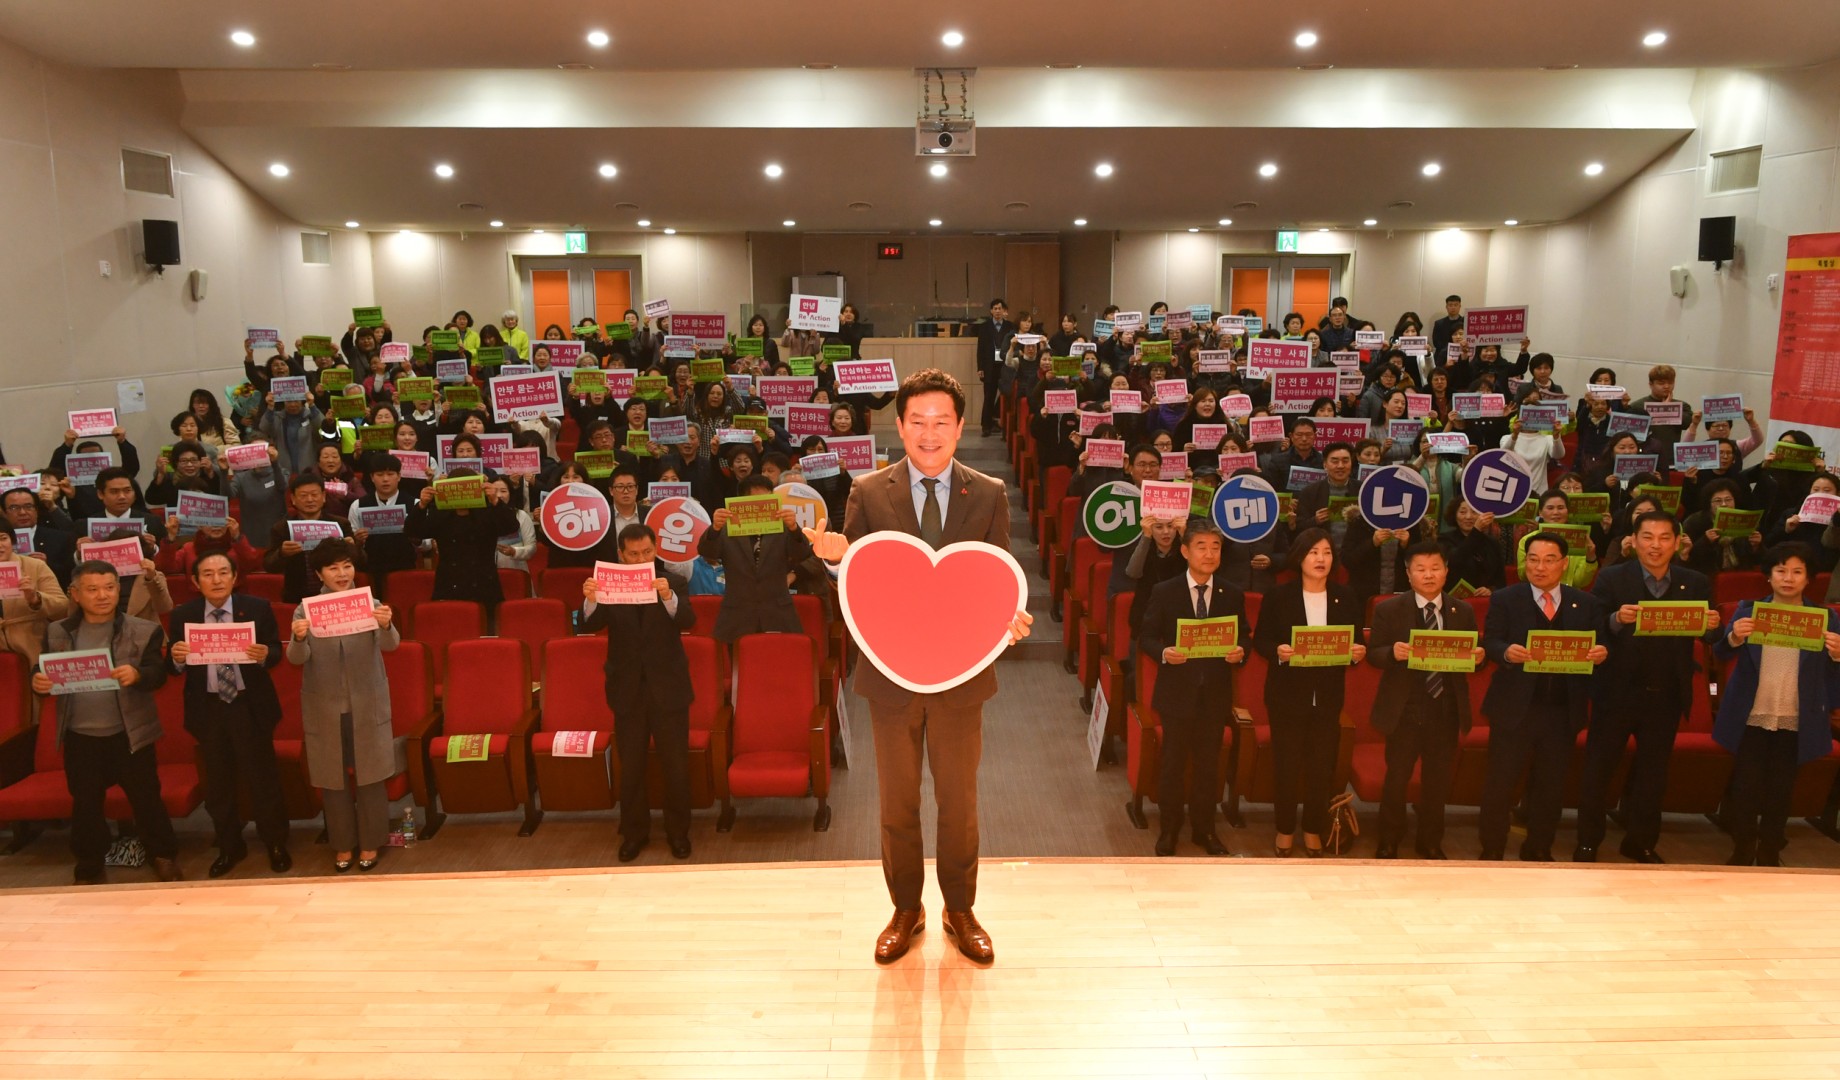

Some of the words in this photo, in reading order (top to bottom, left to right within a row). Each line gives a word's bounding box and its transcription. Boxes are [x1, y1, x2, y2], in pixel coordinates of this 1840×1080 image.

[802, 302, 816, 310] 안녕
[674, 319, 689, 327] 안부
[691, 319, 706, 327] 묻는
[708, 319, 723, 327] 사회
[1469, 315, 1498, 324] 안전한
[1505, 313, 1523, 322] 사회
[565, 348, 580, 356] 사회
[1253, 346, 1282, 358] 안전한
[1288, 349, 1307, 359] 사회
[840, 367, 871, 376] 안심하는
[875, 365, 890, 373] 사회
[618, 377, 632, 386] 사회
[1277, 378, 1309, 387] 안전한
[1315, 377, 1334, 386] 사회
[497, 386, 515, 396] 안부
[517, 382, 534, 393] 묻는
[538, 380, 554, 391] 사회
[762, 385, 794, 394] 안심하는
[797, 385, 812, 394] 사회
[1277, 389, 1334, 397] 전국자원봉사공동행동
[498, 392, 556, 406] 전국자원봉사공동행동
[512, 410, 538, 418] Action
[791, 412, 825, 422] 안심하는
[1315, 427, 1336, 436] 전한
[1342, 427, 1362, 437] 사회
[488, 444, 506, 452] 사회
[852, 445, 870, 455] 사회
[437, 485, 464, 493] 안심하는
[466, 482, 479, 490] 사회
[1475, 465, 1518, 504] 티
[1145, 489, 1168, 498] 안전한
[1174, 491, 1188, 499] 사회
[182, 498, 194, 506] 안부
[1372, 486, 1412, 519] 니
[730, 504, 760, 513] 안심하는
[762, 503, 776, 511] 사회
[1224, 496, 1267, 529] 메
[553, 502, 600, 539] 해
[1094, 500, 1136, 532] 어
[309, 524, 321, 532] 묻는
[658, 512, 694, 553] 운
[85, 552, 101, 560] 안부
[102, 550, 119, 558] 묻는
[121, 548, 138, 556] 사회
[598, 572, 630, 582] 안심하는
[633, 573, 650, 581] 사회
[311, 602, 346, 616] 안심하는
[350, 598, 367, 608] 사회
[1643, 611, 1674, 619] 안전한
[1682, 611, 1702, 620] 사회
[1758, 612, 1791, 624] 안전한
[1800, 617, 1821, 627] 사회
[1182, 627, 1209, 637] 안전한
[1215, 626, 1233, 635] 사회
[191, 633, 208, 642] 안부
[212, 633, 228, 642] 묻는
[232, 632, 249, 641] 사회
[1297, 635, 1324, 644] 안전한
[1331, 635, 1349, 644] 사회
[1415, 639, 1444, 648] 안전한
[1452, 640, 1471, 648] 사회
[1533, 640, 1563, 649] 안전한
[1570, 641, 1590, 649] 사회
[46, 664, 64, 674] 안부
[68, 662, 87, 671] 묻는
[88, 658, 106, 668] 사회
